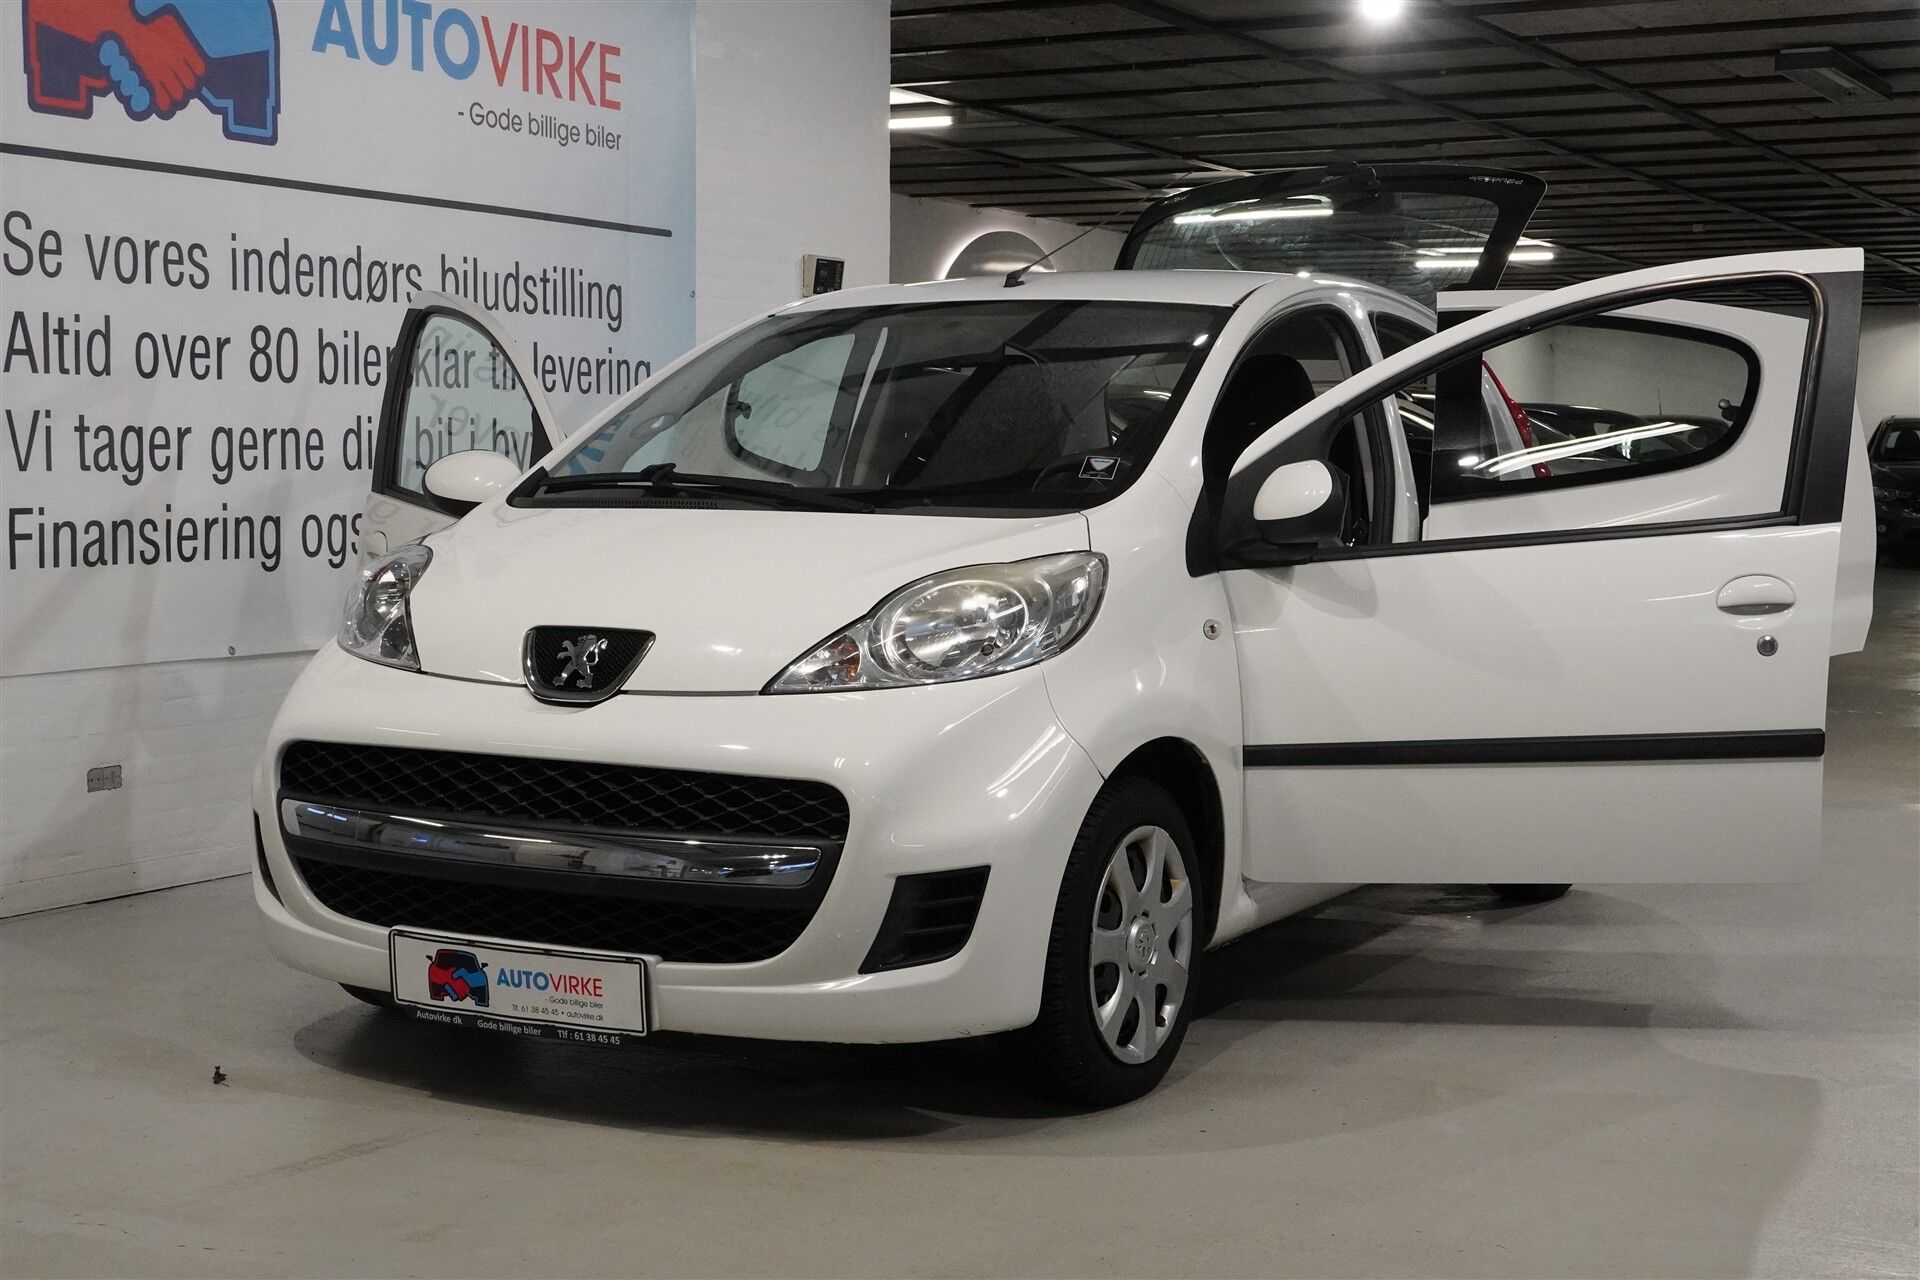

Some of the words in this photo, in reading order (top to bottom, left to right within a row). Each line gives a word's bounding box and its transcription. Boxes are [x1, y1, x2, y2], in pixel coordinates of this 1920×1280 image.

[311, 0, 621, 111] AUTOVIRKE
[469, 101, 523, 133] Gode
[528, 112, 580, 147] billige
[586, 123, 621, 150] biler
[3, 210, 63, 277] Se
[84, 233, 210, 290] vores
[230, 232, 423, 304] indendørs
[441, 253, 623, 332] biludstilling
[3, 310, 111, 377] Altid
[135, 331, 231, 380] over
[249, 324, 298, 384] 80
[415, 335, 476, 389] klar
[5, 409, 53, 472] Vi
[74, 414, 192, 487] tager
[210, 424, 324, 485] gerne
[8, 503, 281, 572] Finansiering
[497, 967, 603, 997] AUTOVIRKE
[549, 996, 568, 1006] Gode
[416, 1010, 451, 1022] Autovirke
[477, 1020, 498, 1030] Gode
[499, 1022, 522, 1035] billige
[523, 1025, 542, 1036] biler
[541, 1007, 549, 1015] 45
[551, 1008, 559, 1016] 45
[574, 1031, 585, 1041] 61
[586, 1033, 597, 1042] 38
[598, 1034, 609, 1044] 45
[610, 1035, 621, 1045] 45
